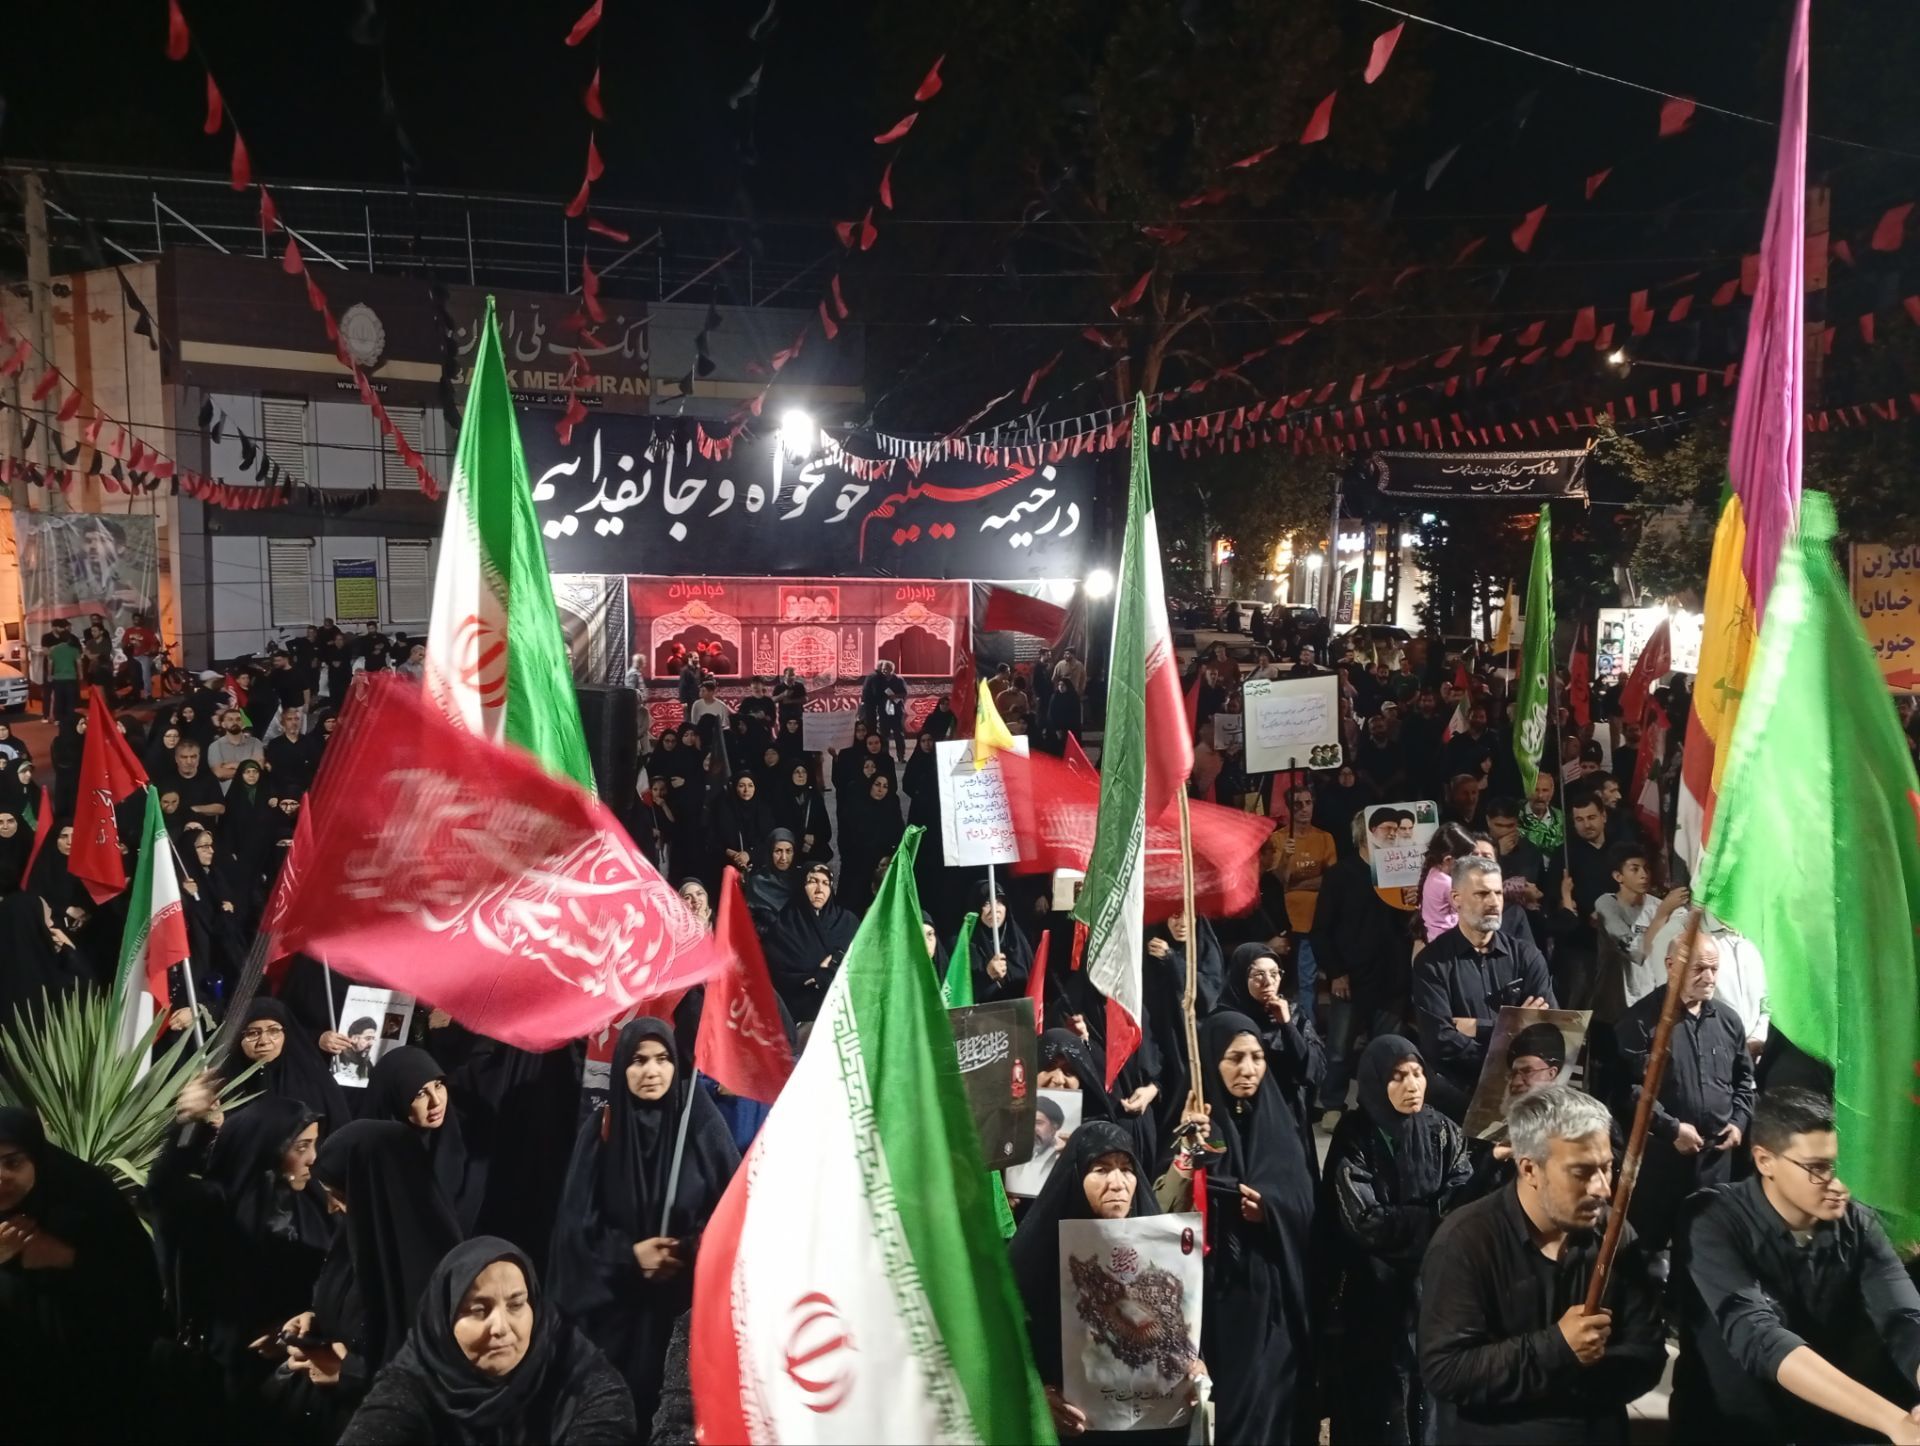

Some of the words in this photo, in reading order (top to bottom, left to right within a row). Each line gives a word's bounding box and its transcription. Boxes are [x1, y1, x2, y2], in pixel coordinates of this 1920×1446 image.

[457, 309, 515, 356] ایان
[523, 370, 594, 392] MEL
[980, 465, 1057, 549] خیمه
[669, 580, 725, 598] خواهران
[895, 585, 936, 601] برادران
[1859, 588, 1912, 618] خیابان
